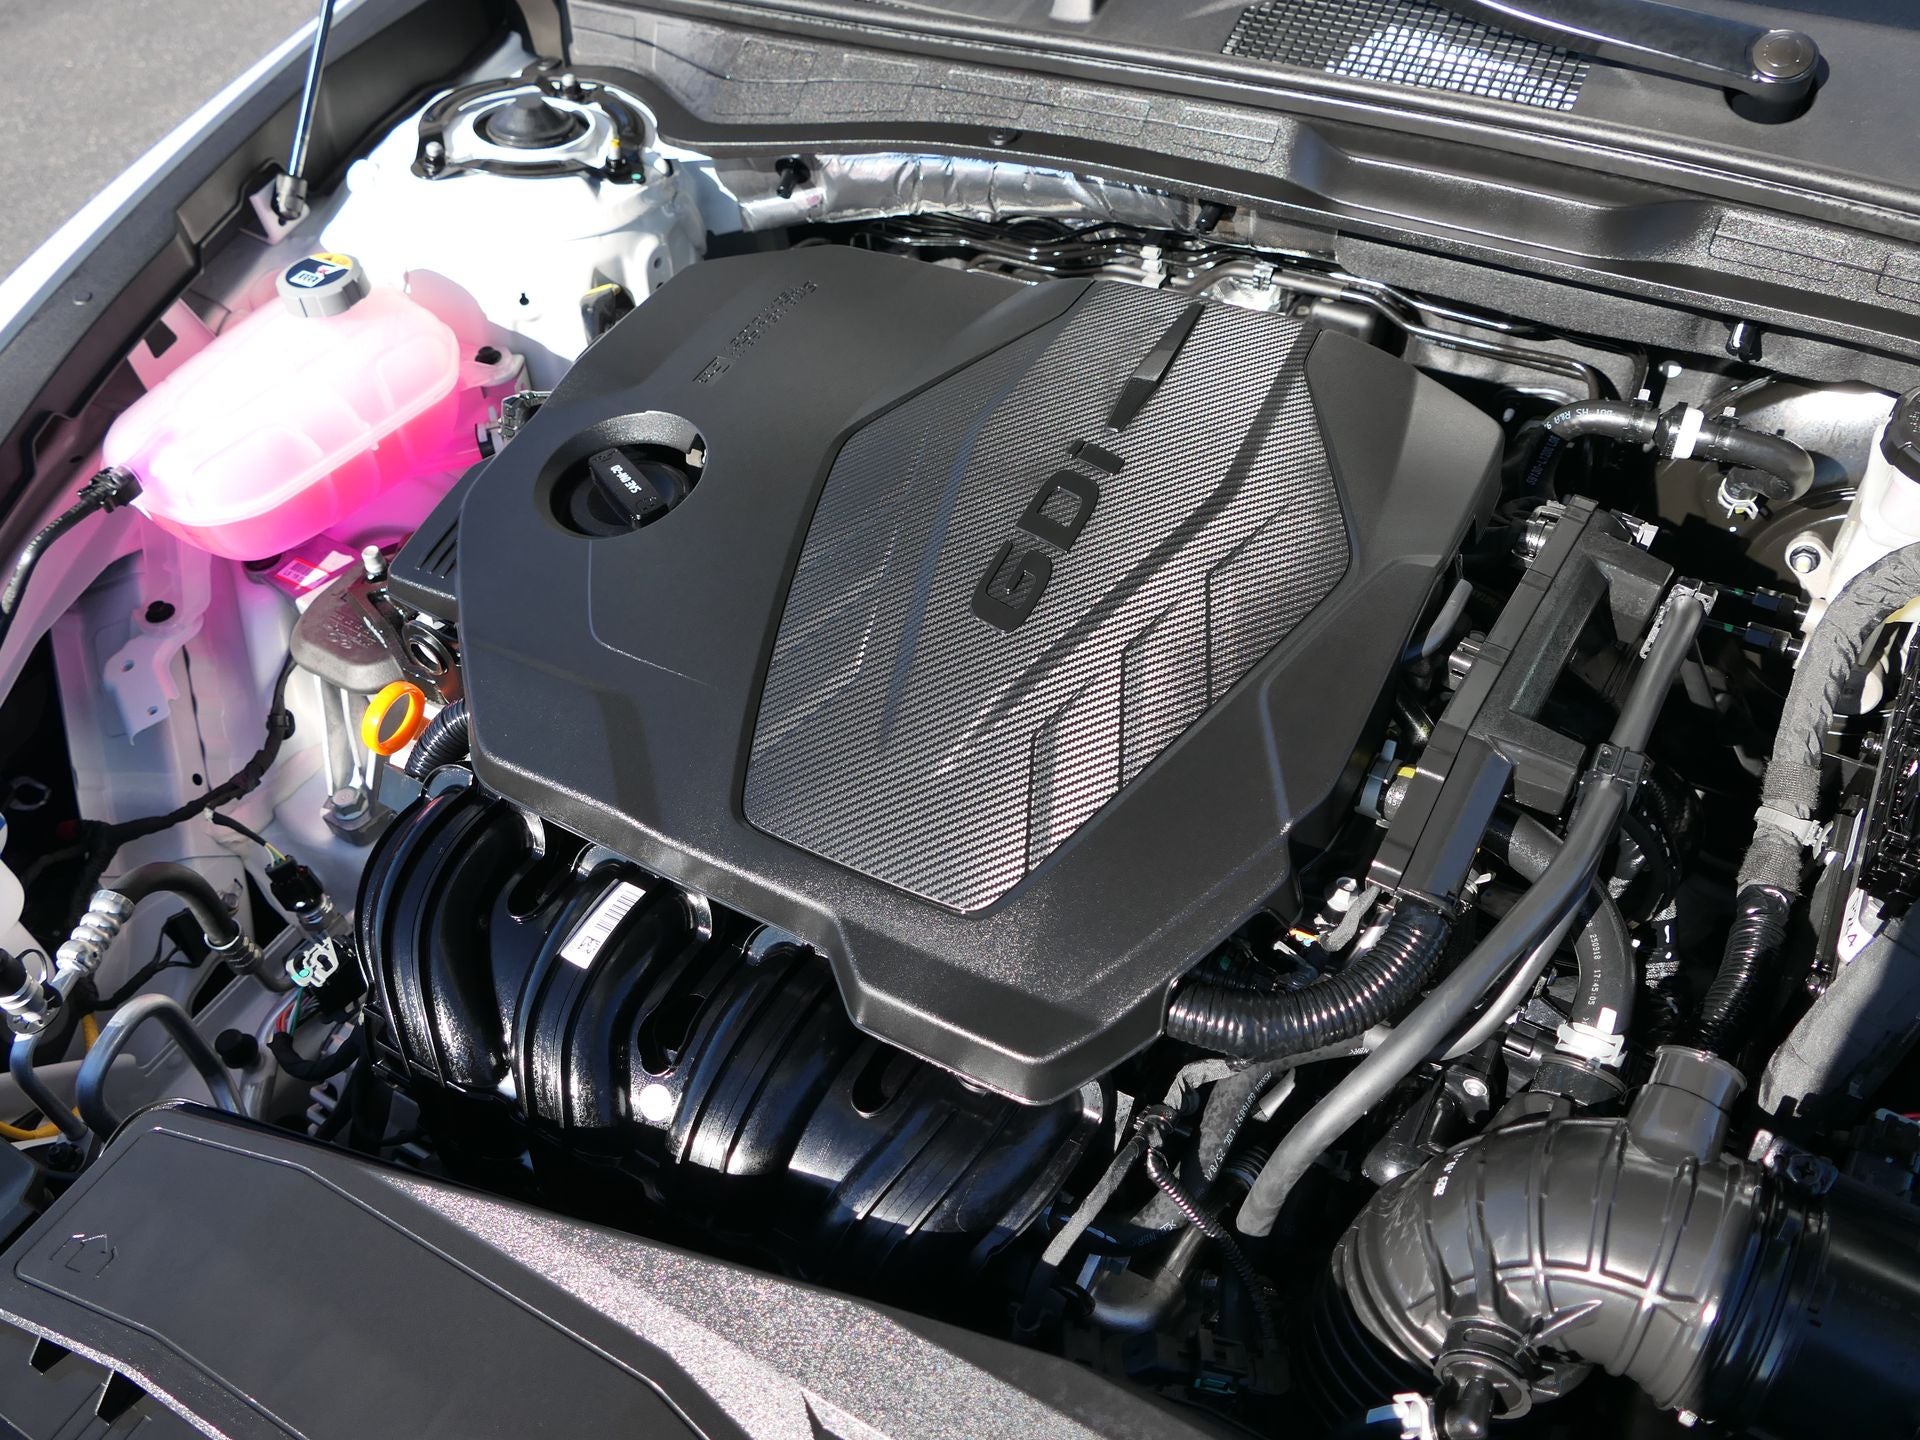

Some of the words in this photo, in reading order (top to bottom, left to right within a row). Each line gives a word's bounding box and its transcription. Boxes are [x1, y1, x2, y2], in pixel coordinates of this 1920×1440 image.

[1575, 408, 1589, 417] HS
[610, 464, 632, 483] 0W-20
[624, 479, 642, 494] SAE
[970, 438, 1126, 635] GDi
[1589, 933, 1602, 960] 250918
[1587, 969, 1602, 1006] 17:45:05
[1234, 1092, 1256, 1128] GB16897
